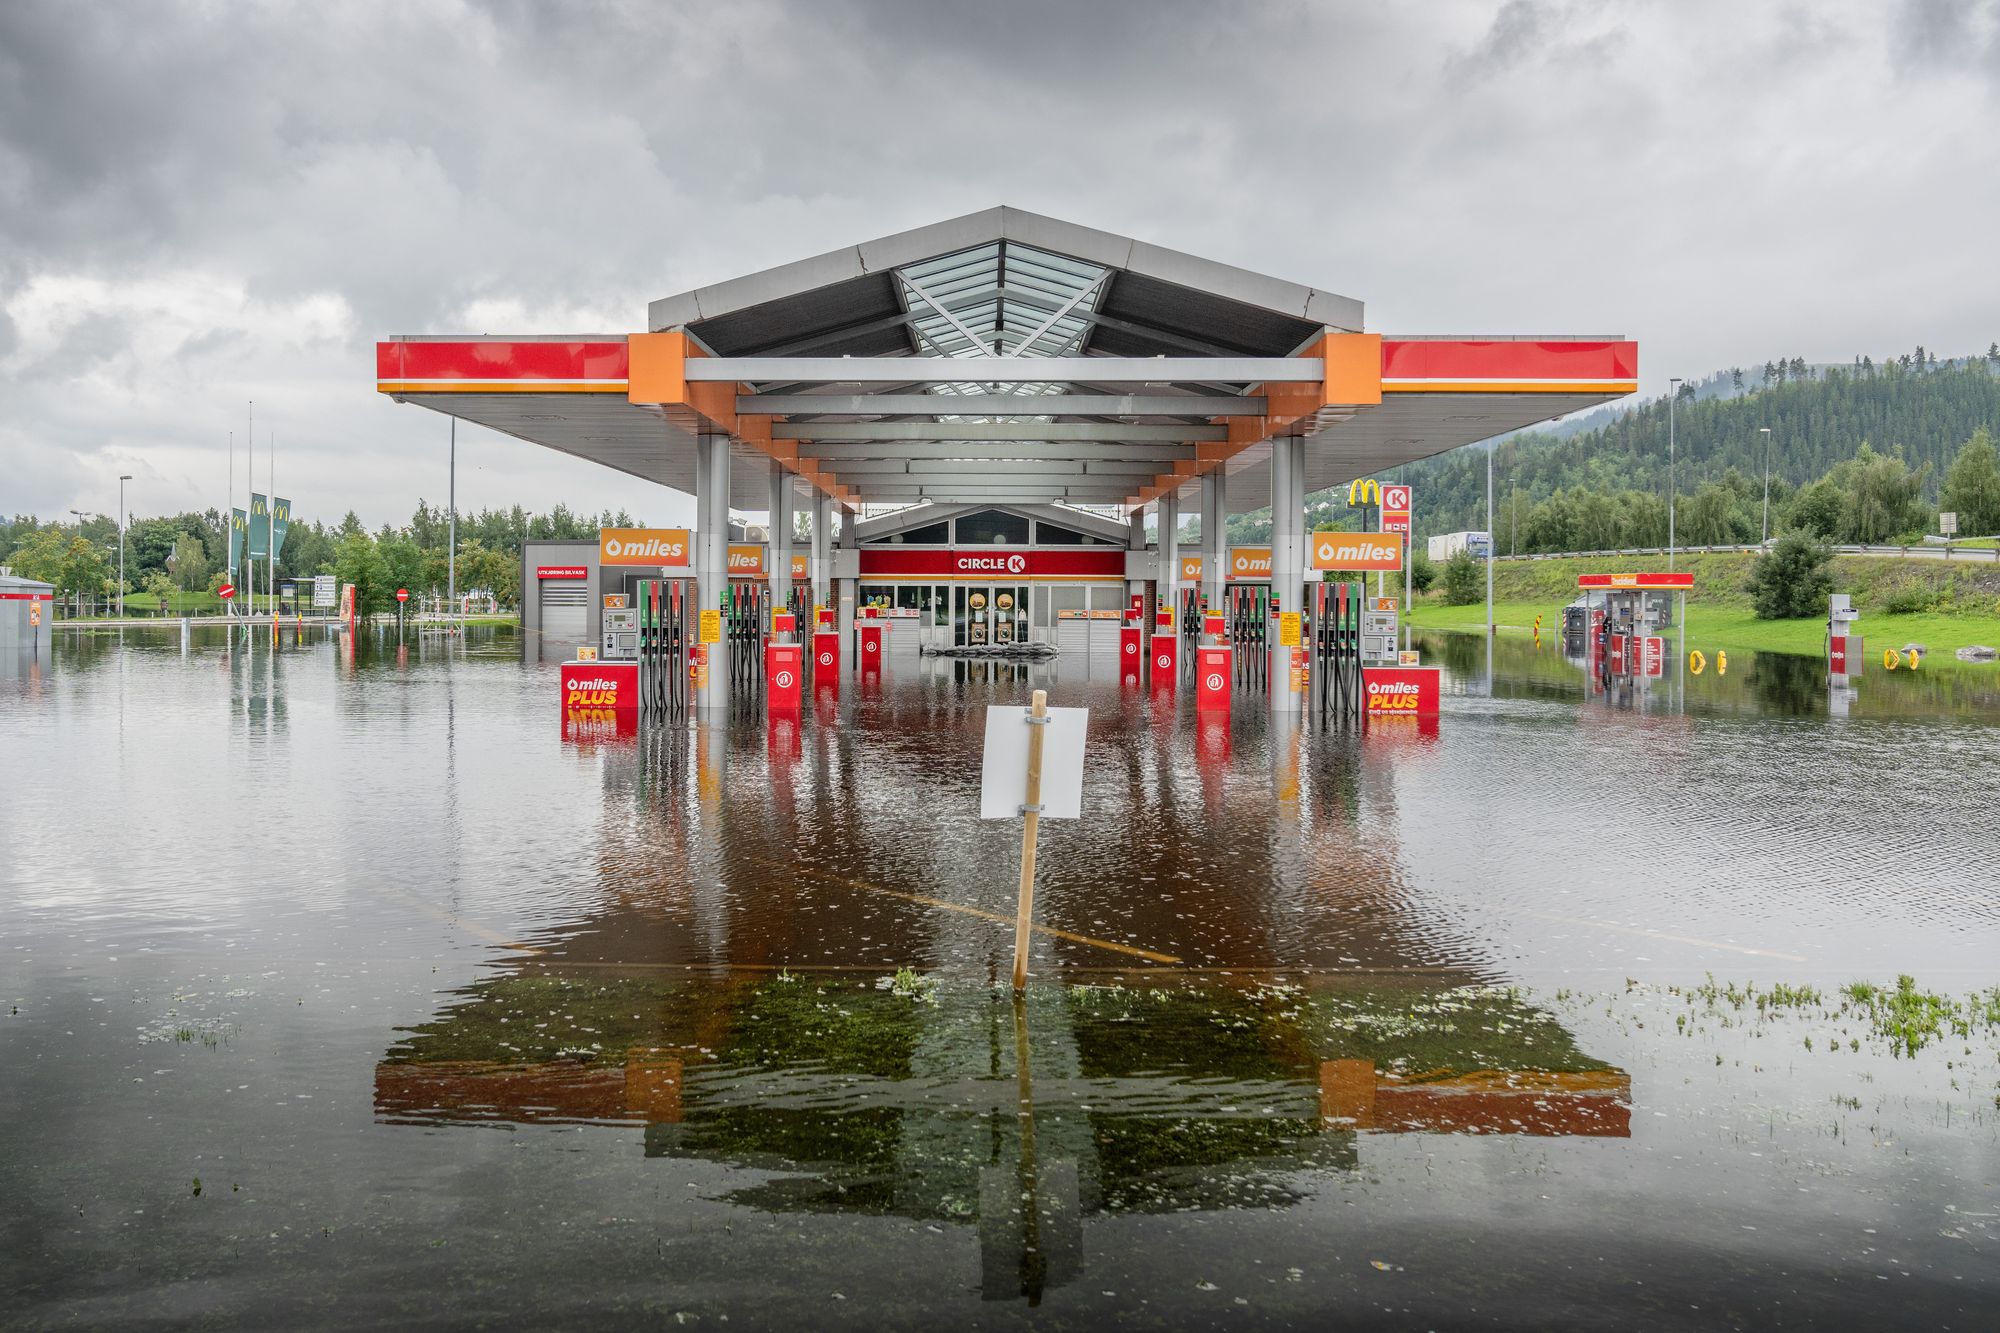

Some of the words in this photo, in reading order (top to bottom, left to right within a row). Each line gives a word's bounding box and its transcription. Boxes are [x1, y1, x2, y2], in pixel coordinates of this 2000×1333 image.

[1389, 491, 1406, 508] K
[623, 539, 683, 557] miles
[1336, 543, 1396, 561] miles
[728, 553, 758, 567] iles
[957, 558, 1005, 569] CIRCLE
[1009, 557, 1025, 572] K
[578, 678, 618, 690] miles
[1379, 682, 1420, 694] miles
[567, 690, 618, 705] PLUS
[1368, 694, 1420, 709] PLUS
